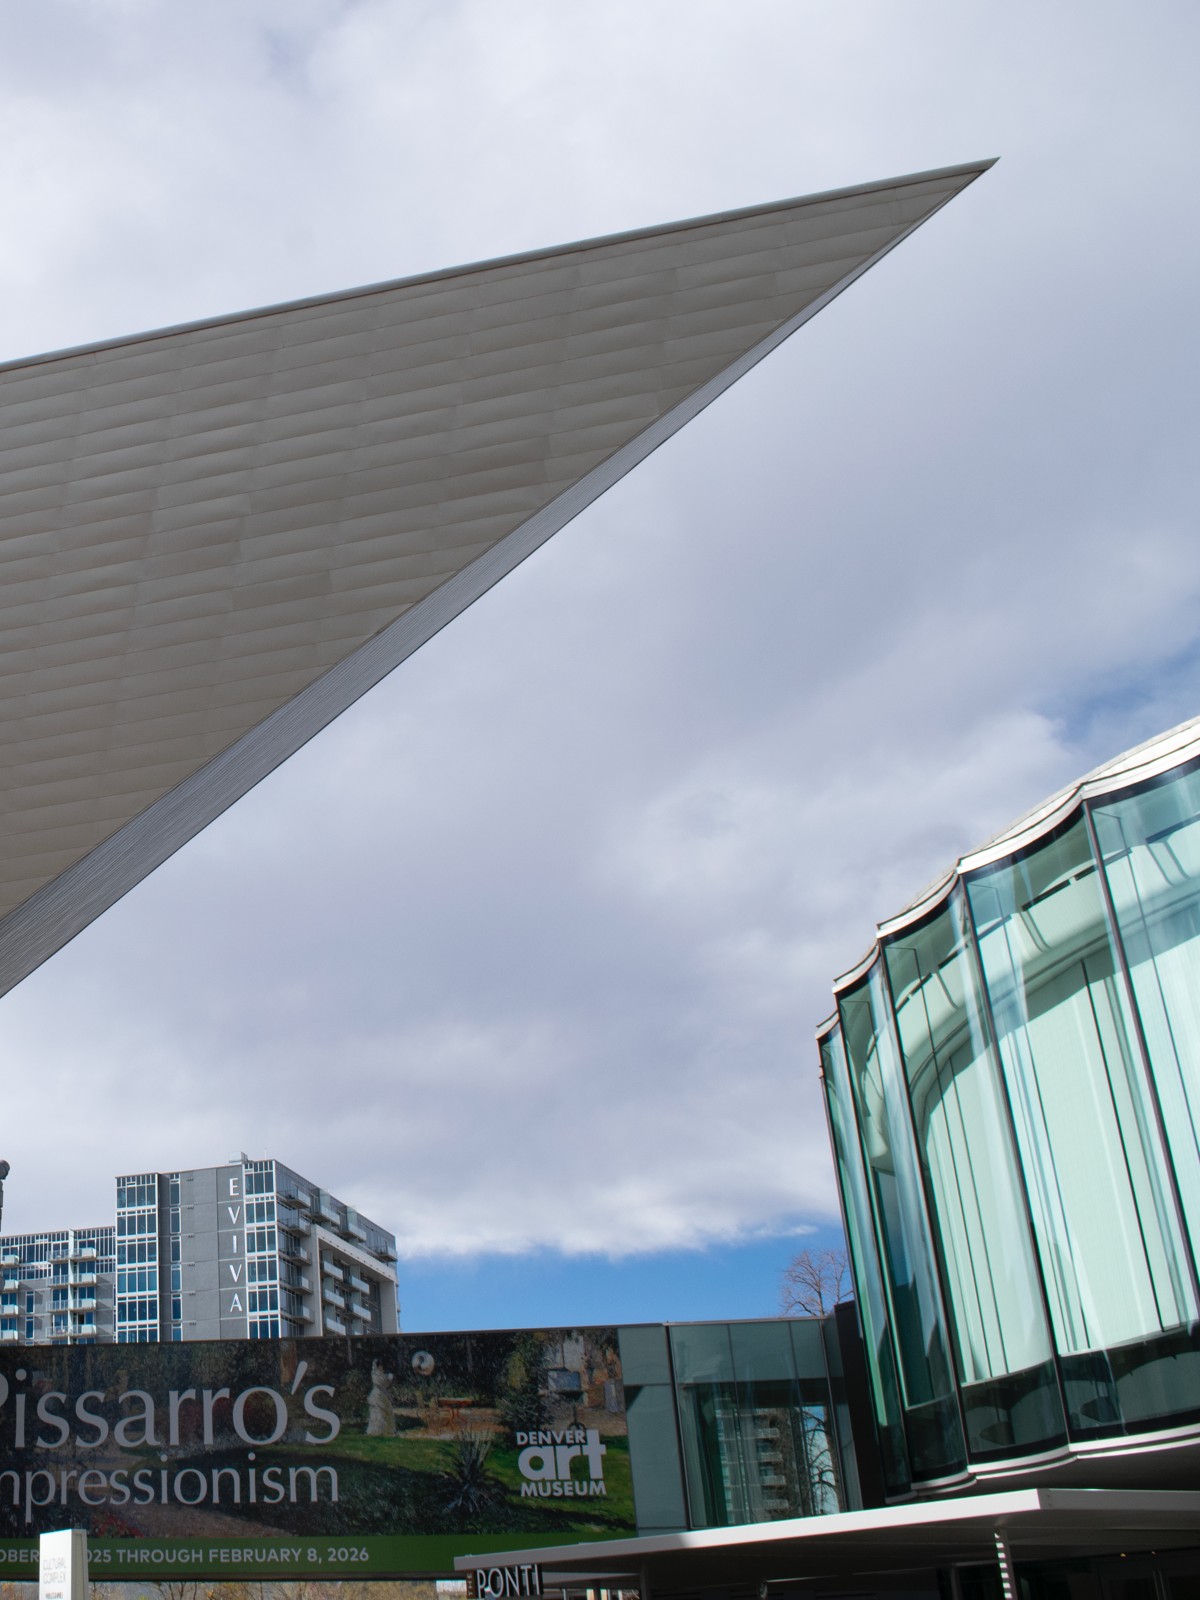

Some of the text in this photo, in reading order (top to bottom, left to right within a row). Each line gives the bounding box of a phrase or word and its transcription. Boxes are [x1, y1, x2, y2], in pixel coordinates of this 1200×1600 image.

[228, 1177, 243, 1312] EVIVA
[516, 1430, 586, 1446] DENVER
[517, 1429, 607, 1481] art
[520, 1480, 607, 1497] MUSEUM
[116, 1548, 203, 1563] THROUGH
[208, 1548, 302, 1563] FEBRUARY
[306, 1547, 322, 1565] 8,
[327, 1547, 370, 1562] 2026
[476, 1563, 540, 1599] PONTI
